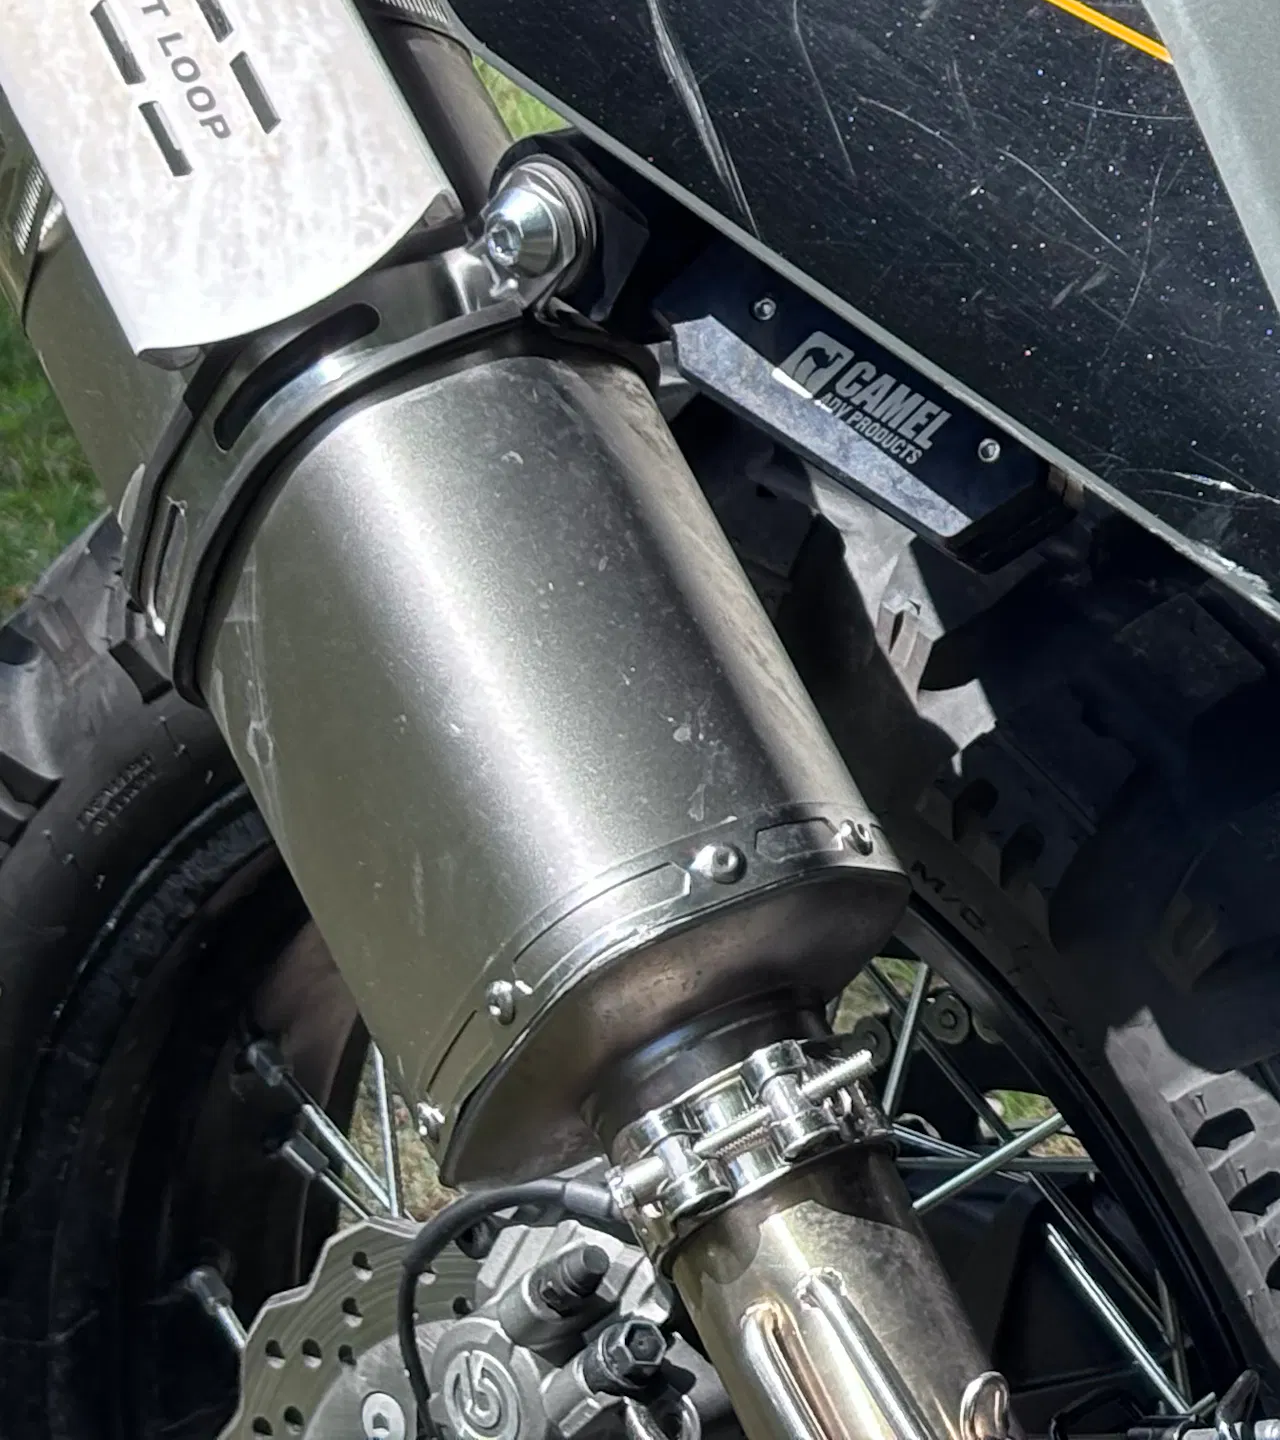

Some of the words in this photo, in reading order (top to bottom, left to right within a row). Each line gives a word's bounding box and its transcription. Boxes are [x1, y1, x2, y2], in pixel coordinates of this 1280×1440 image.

[157, 32, 232, 139] LOOP
[835, 361, 952, 450] CAMEL
[847, 411, 923, 464] PRODUCTS
